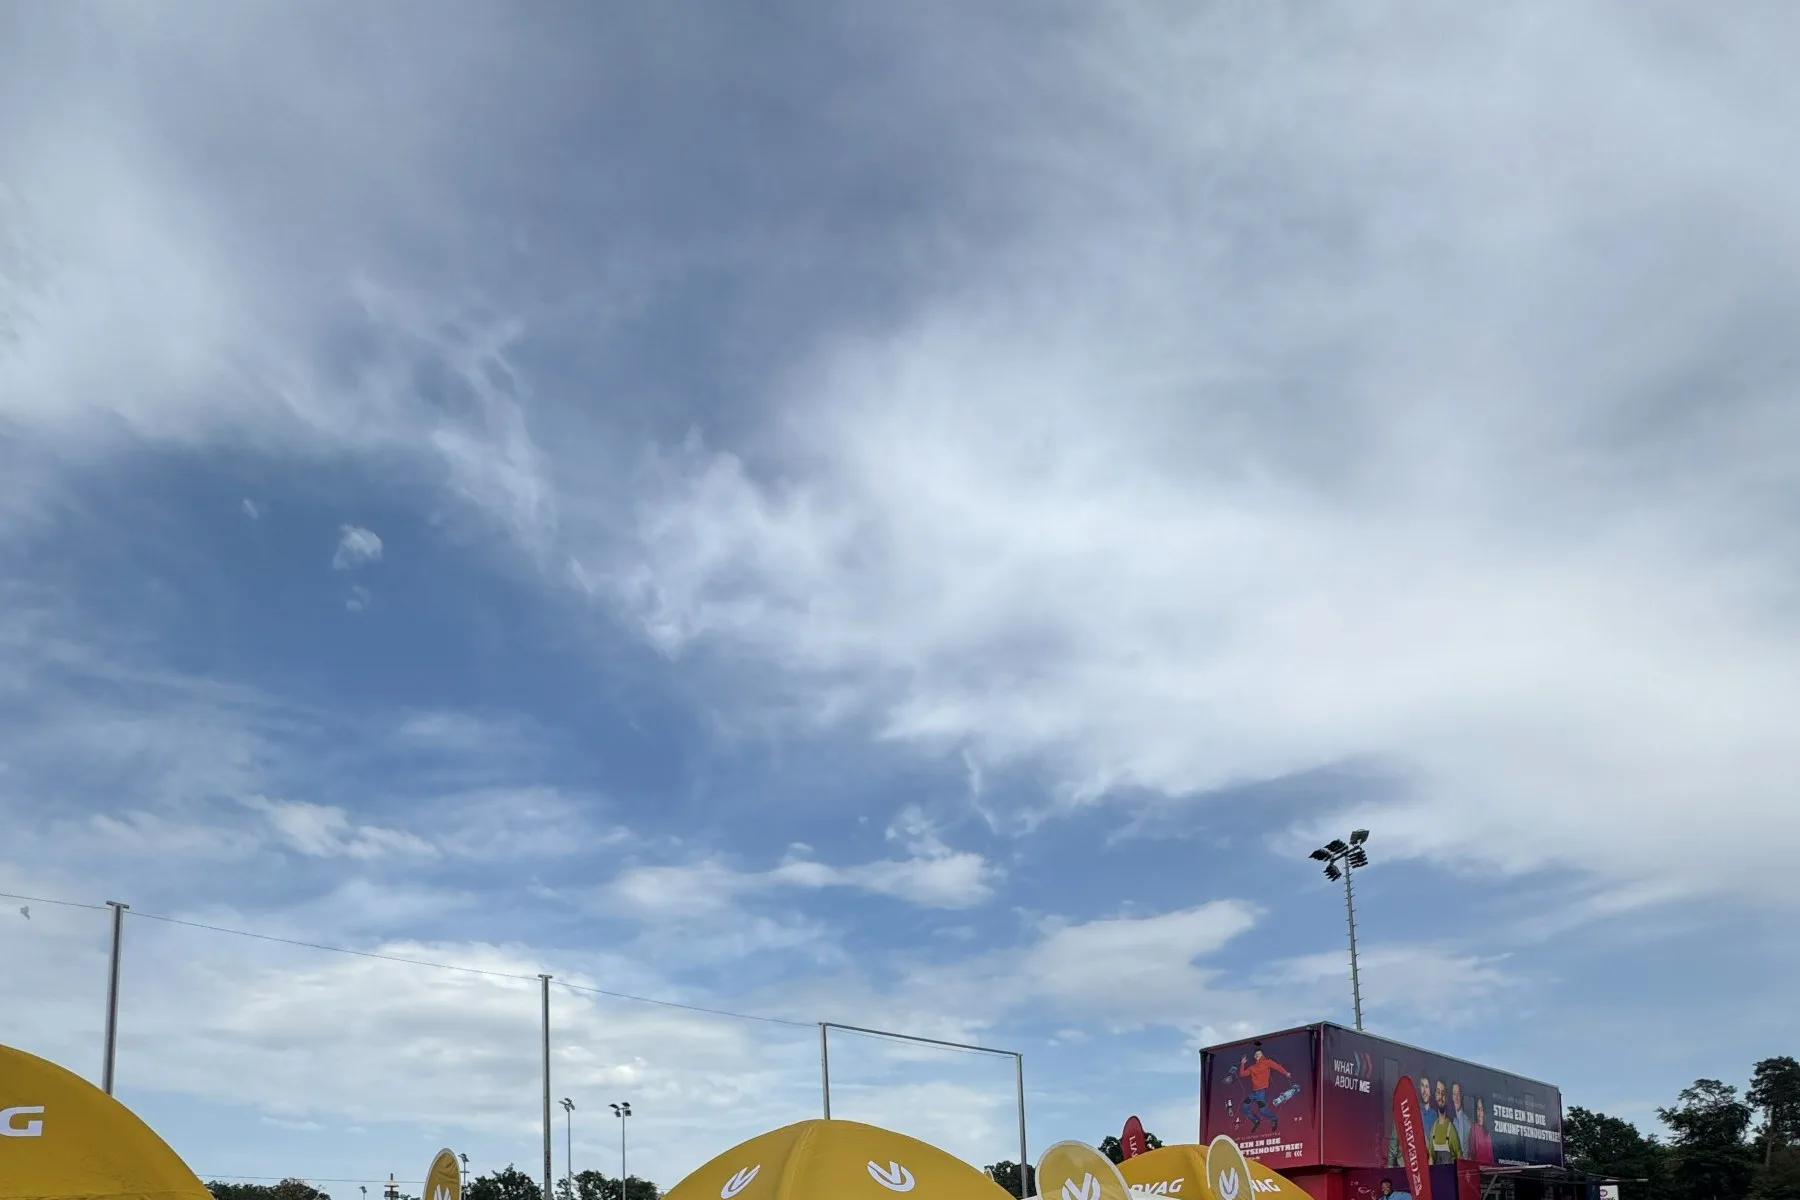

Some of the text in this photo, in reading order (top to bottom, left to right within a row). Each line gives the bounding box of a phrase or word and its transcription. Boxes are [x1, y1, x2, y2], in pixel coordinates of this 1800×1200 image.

[1333, 1059, 1355, 1075] WHAT
[1335, 1075, 1371, 1093] ABOUT ME
[1493, 1104, 1513, 1119] STEIG
